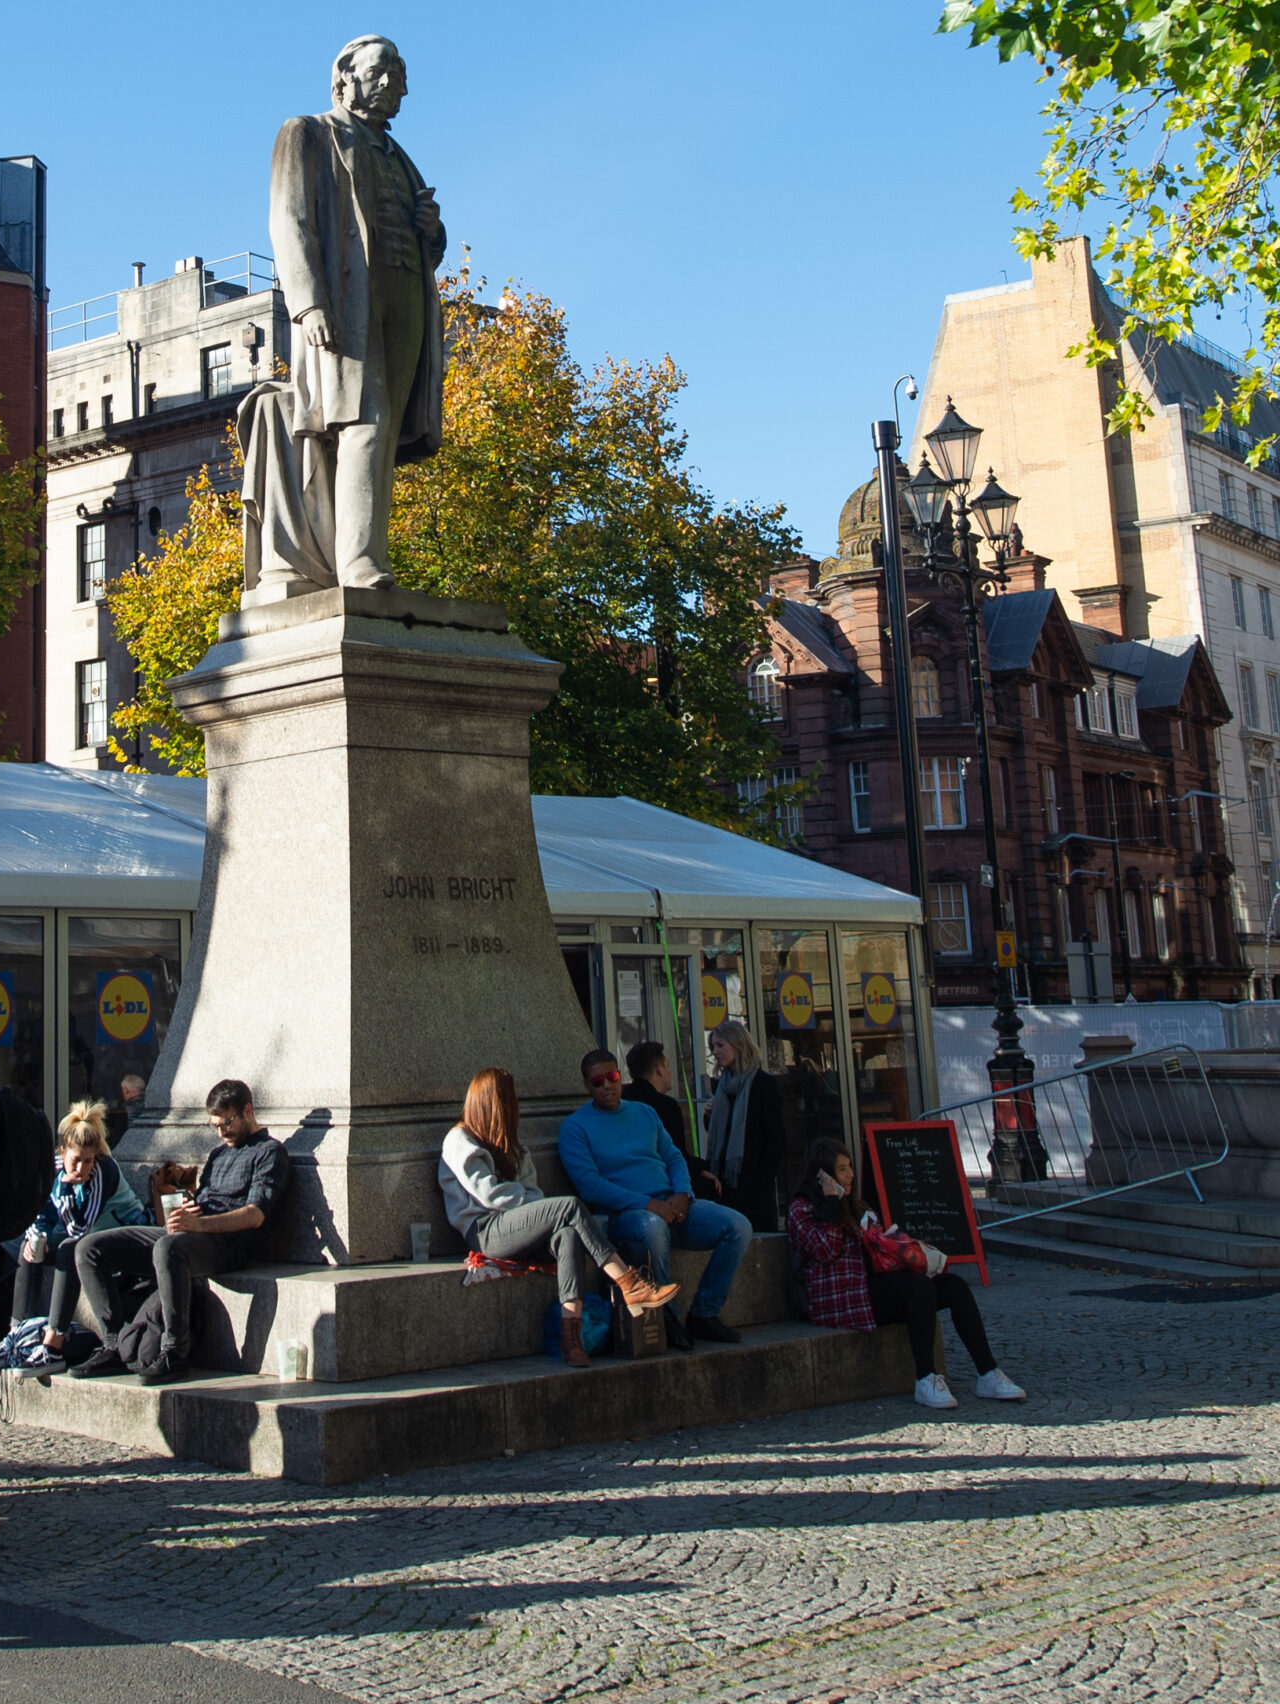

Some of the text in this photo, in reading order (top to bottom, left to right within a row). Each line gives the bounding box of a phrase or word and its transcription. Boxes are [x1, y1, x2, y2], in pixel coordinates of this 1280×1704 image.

[383, 876, 435, 900] JOHN
[413, 936, 441, 954] 1811
[936, 985, 980, 997] BETFRED
